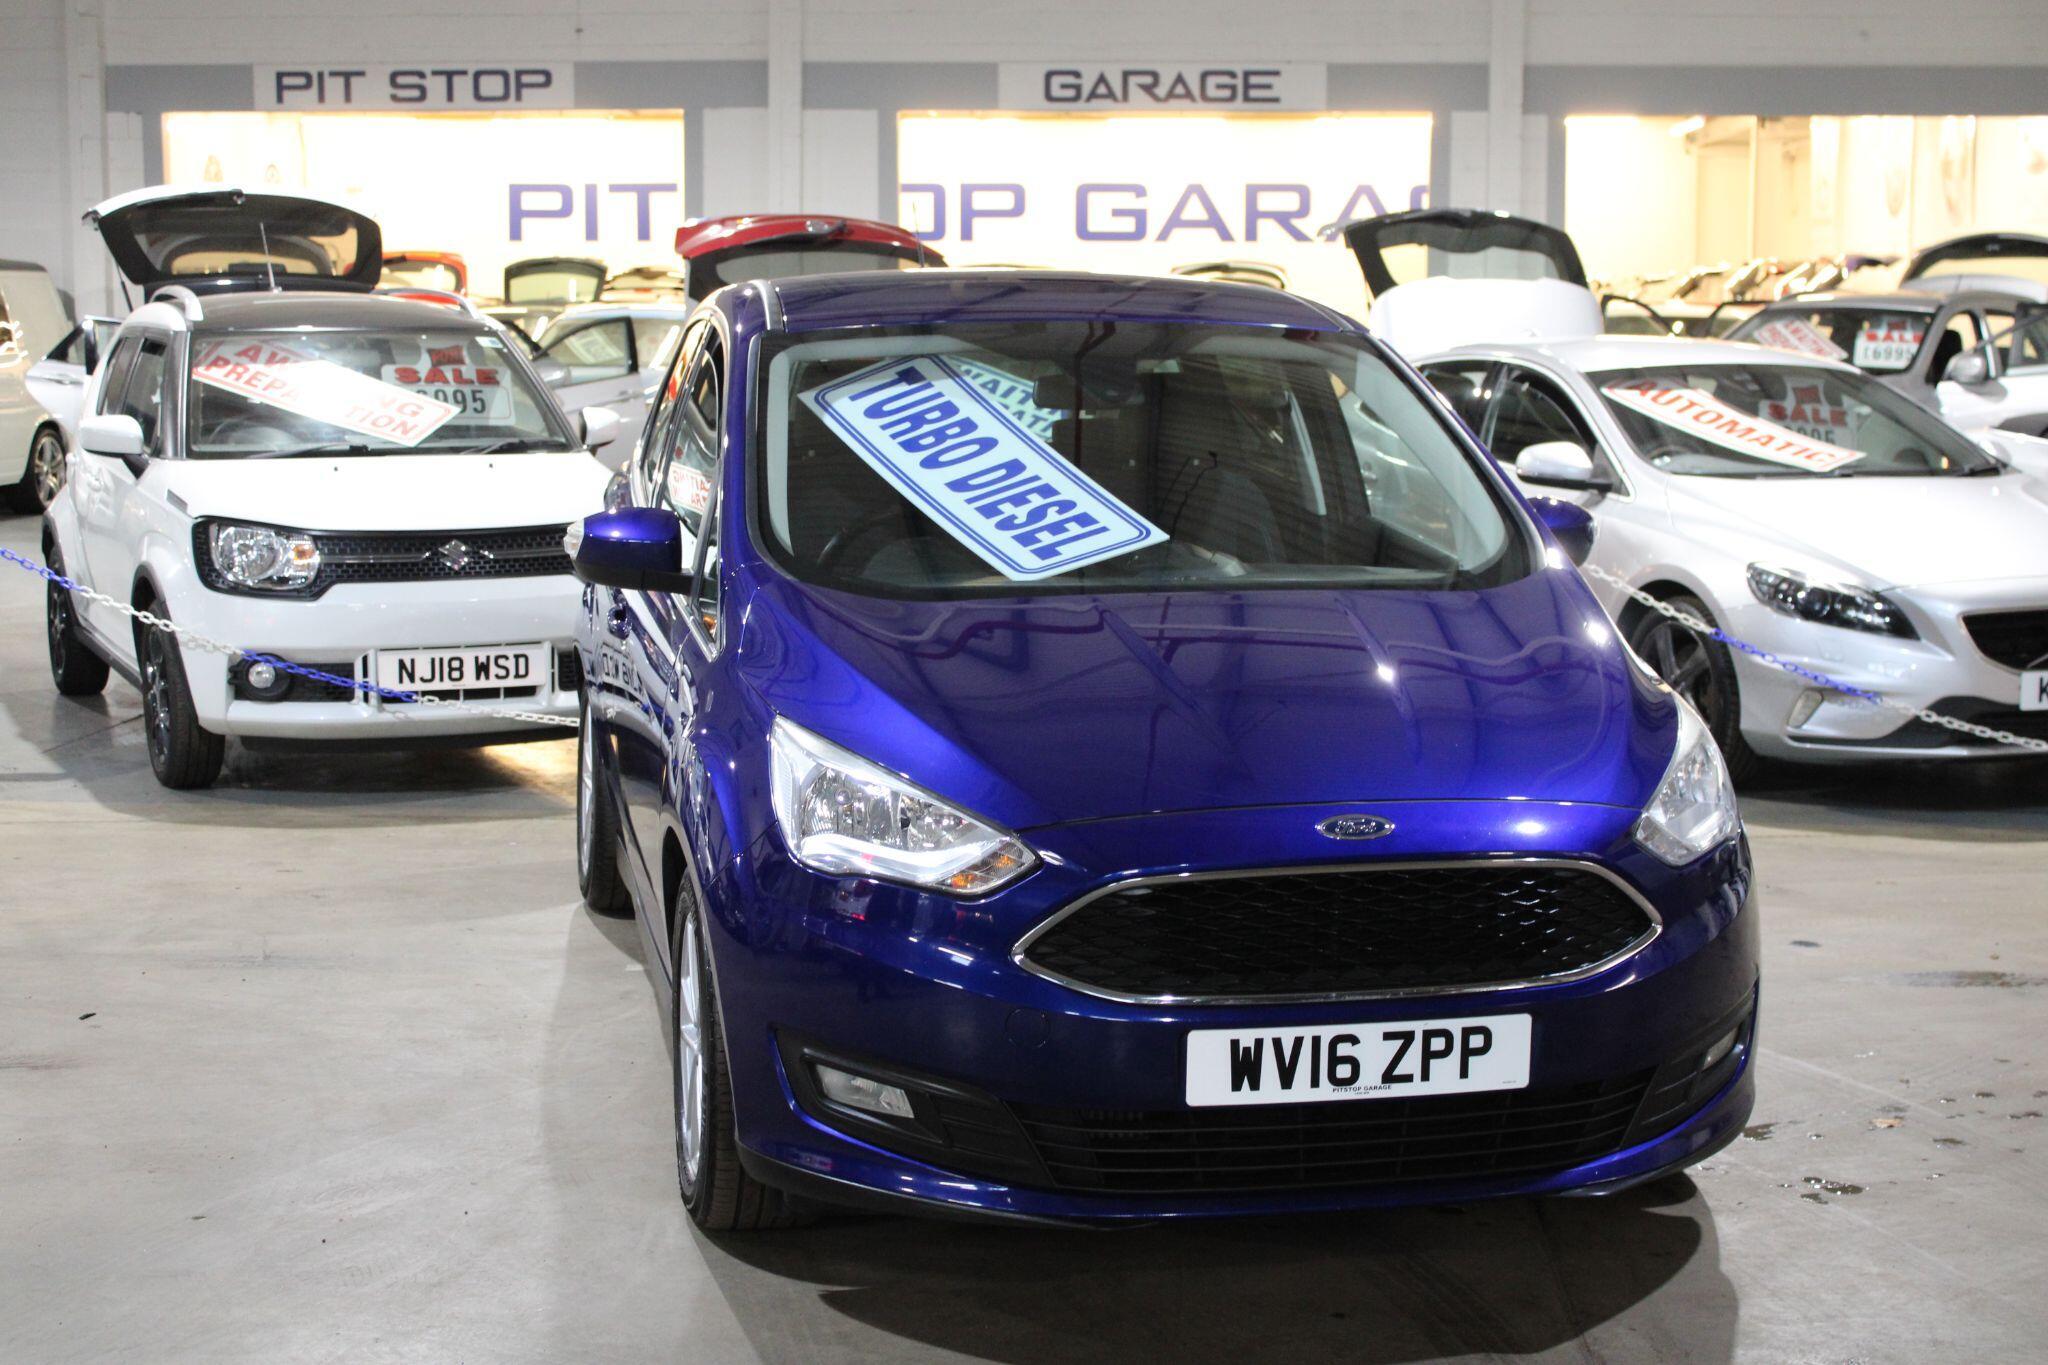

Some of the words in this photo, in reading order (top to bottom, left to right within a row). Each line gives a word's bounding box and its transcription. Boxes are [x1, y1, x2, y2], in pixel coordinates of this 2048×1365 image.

[276, 70, 365, 104] PIT
[389, 69, 553, 103] STOP
[1044, 69, 1282, 103] GARAGE
[508, 183, 678, 242] PIT
[394, 367, 500, 385] SALE
[415, 389, 486, 414] 995
[1768, 402, 1848, 427] SALE
[1626, 382, 1837, 464] AUTOMATIC
[848, 366, 999, 470] TURBO
[945, 458, 1110, 561] DIESEL
[398, 656, 464, 685] NJ18
[474, 653, 530, 681] WSD
[1229, 1032, 1362, 1093] WV16
[1381, 1025, 1493, 1085] ZPP
